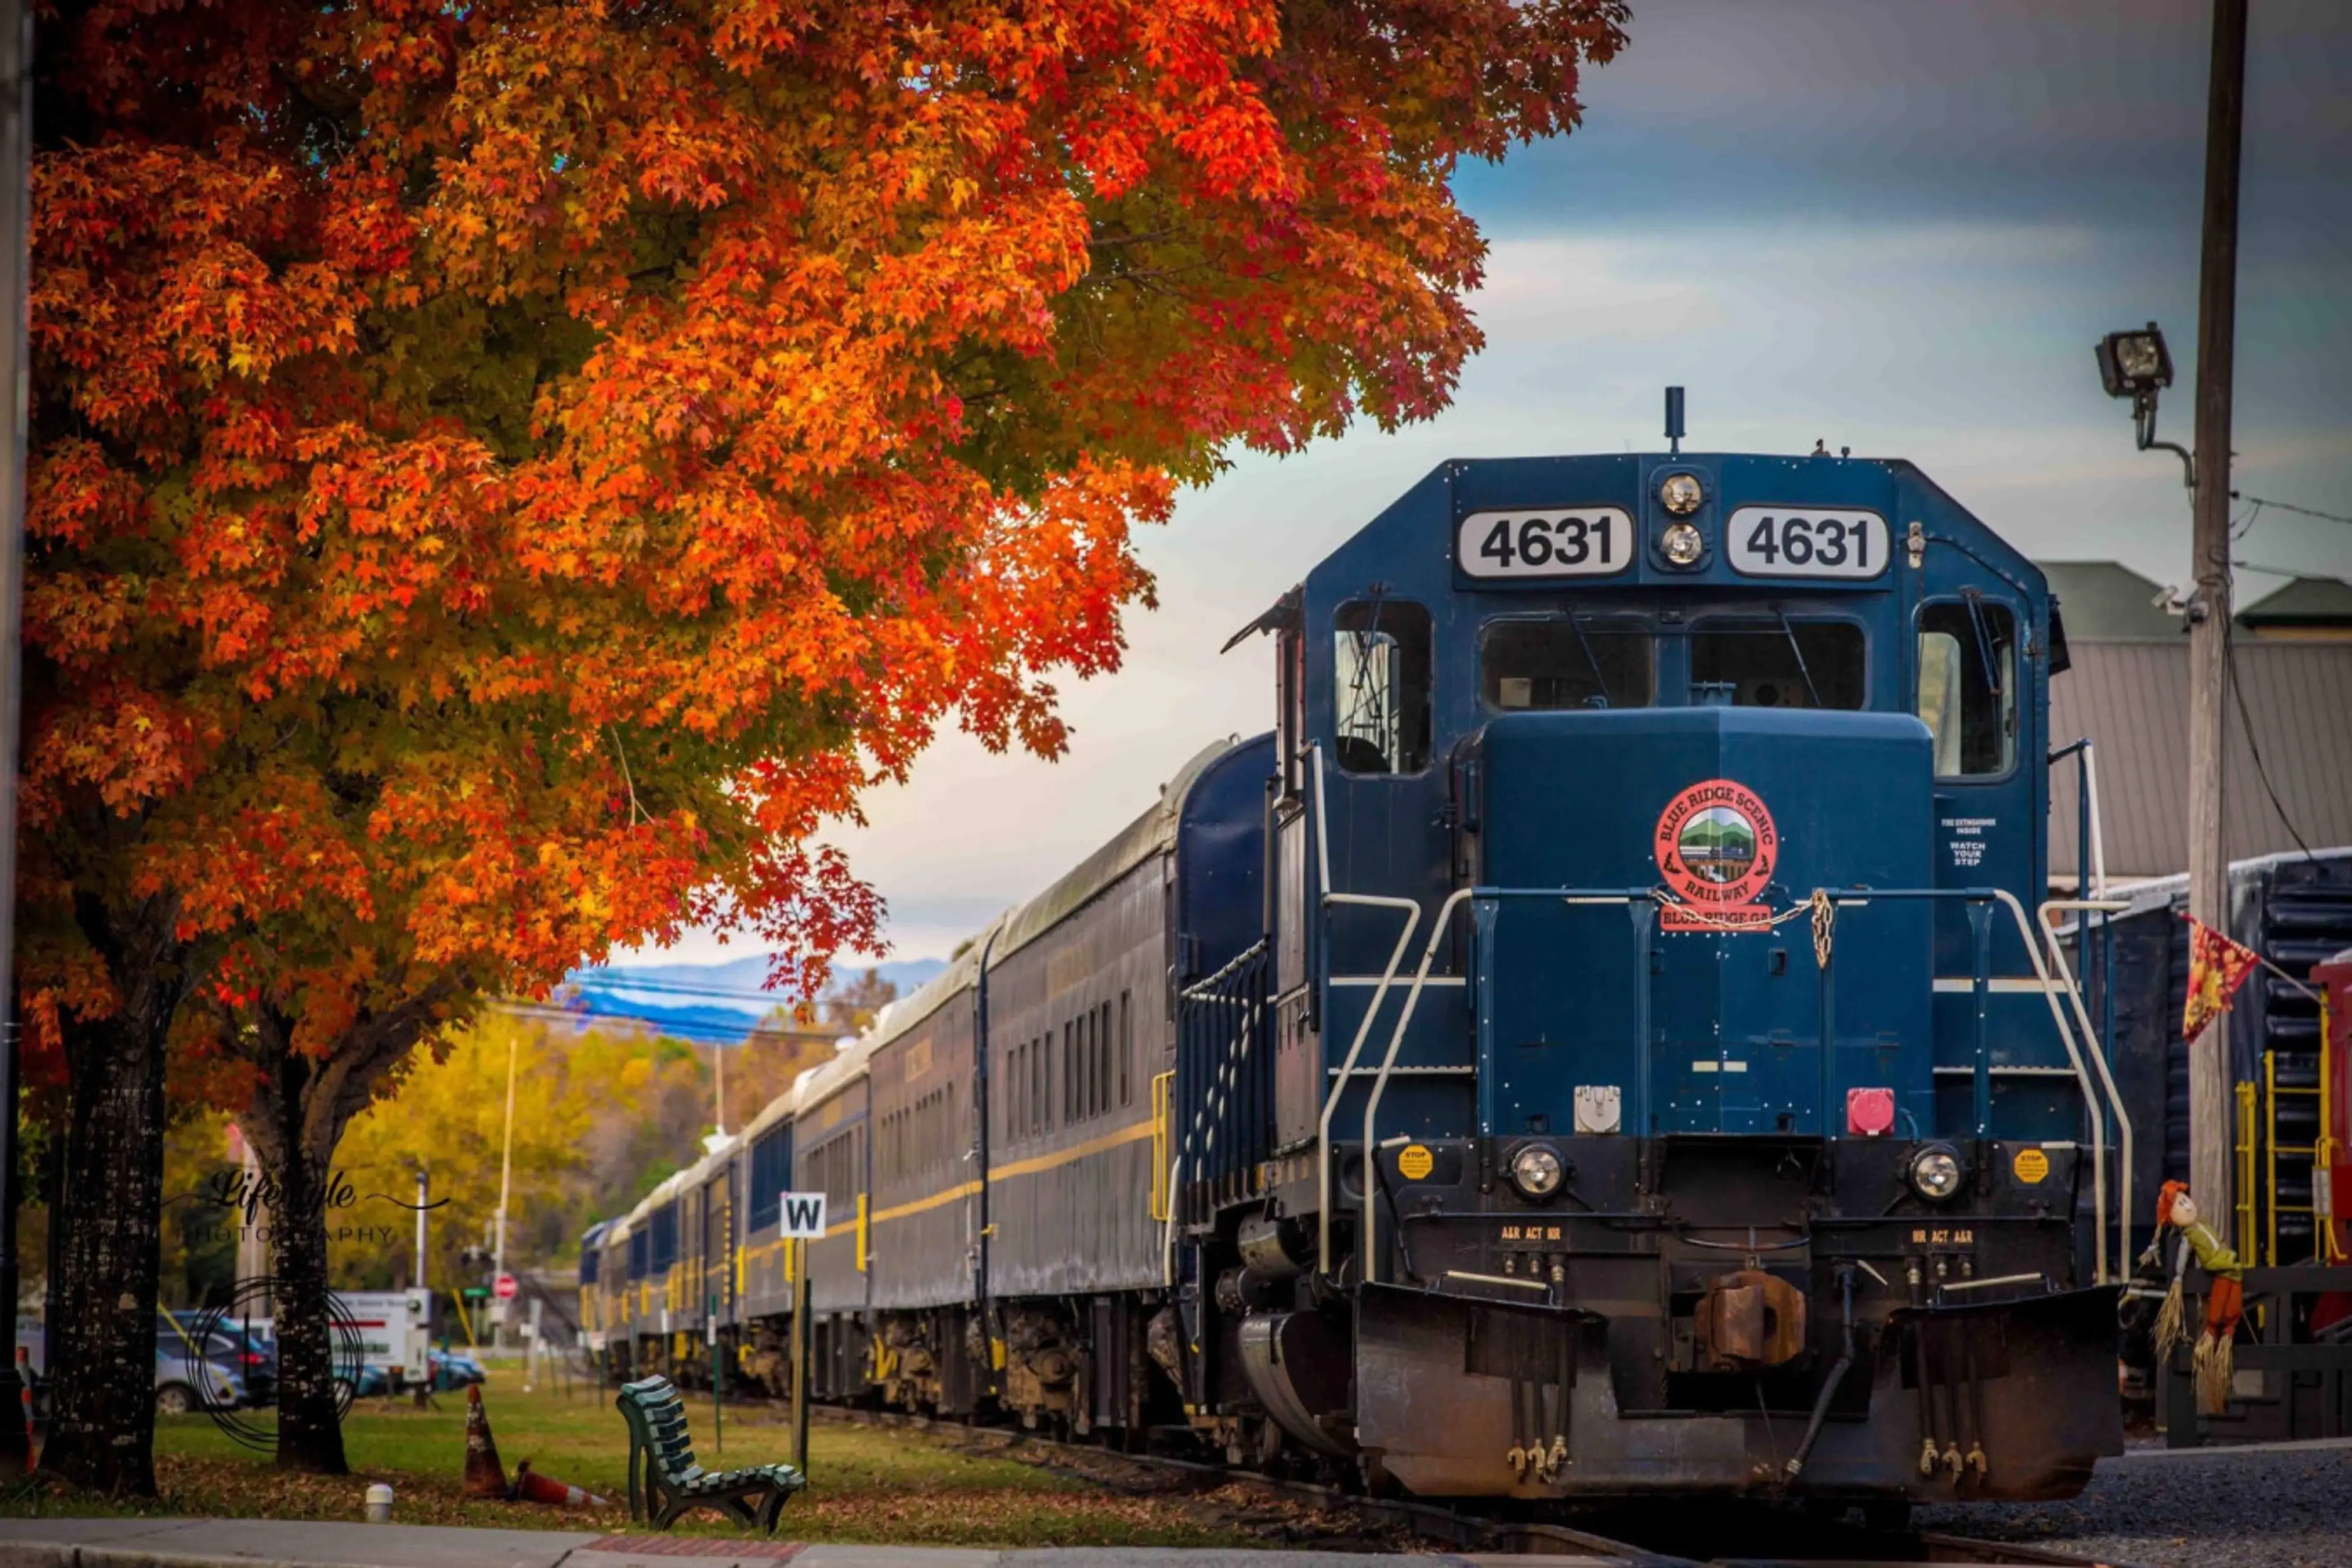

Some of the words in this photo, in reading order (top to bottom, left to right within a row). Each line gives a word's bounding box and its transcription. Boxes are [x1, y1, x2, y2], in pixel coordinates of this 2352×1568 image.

[1480, 516, 1612, 567] 4631
[1747, 515, 1868, 567] 4631
[1660, 801, 1688, 842] BLUE
[1687, 787, 1734, 807] RIDGE
[1736, 793, 1773, 846] SCENIC
[1684, 880, 1749, 902] RAILWAY
[786, 1199, 821, 1231] W
[1526, 1226, 1543, 1240] ACT
